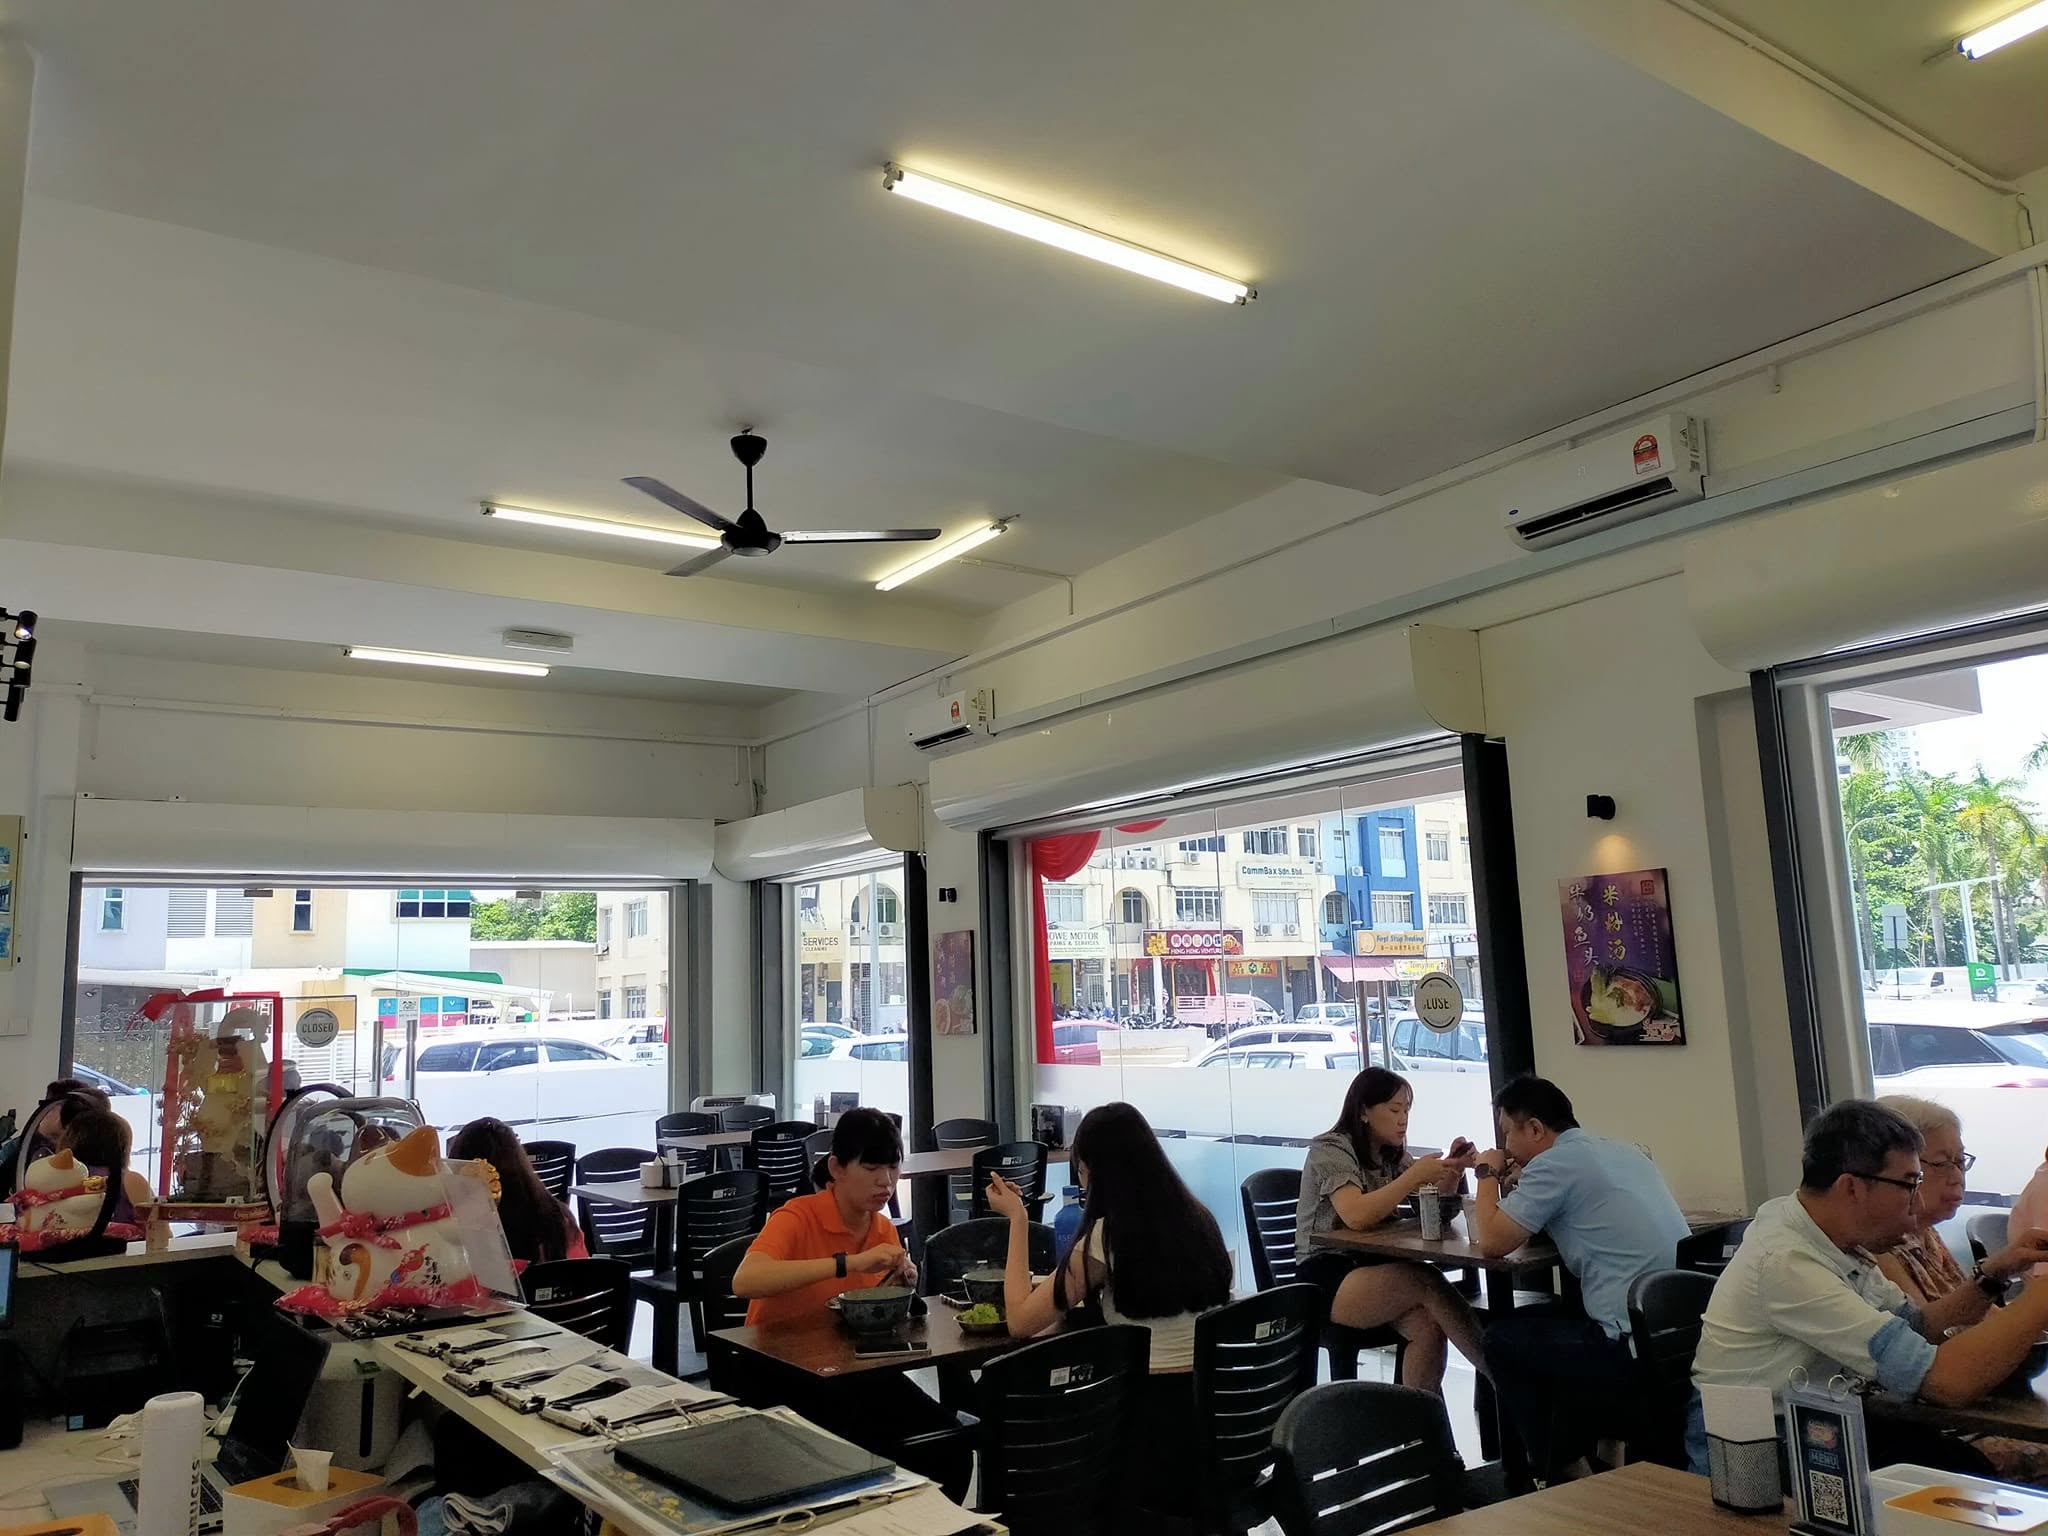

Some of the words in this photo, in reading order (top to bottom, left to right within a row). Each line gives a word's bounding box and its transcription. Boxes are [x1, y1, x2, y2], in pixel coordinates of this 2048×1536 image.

[1603, 885, 1626, 961] 米粉汤
[1070, 932, 1099, 940] MOTOR
[803, 937, 839, 946] SERVICES
[302, 1023, 334, 1033] CLOSED
[1809, 1451, 1837, 1466] MENU
